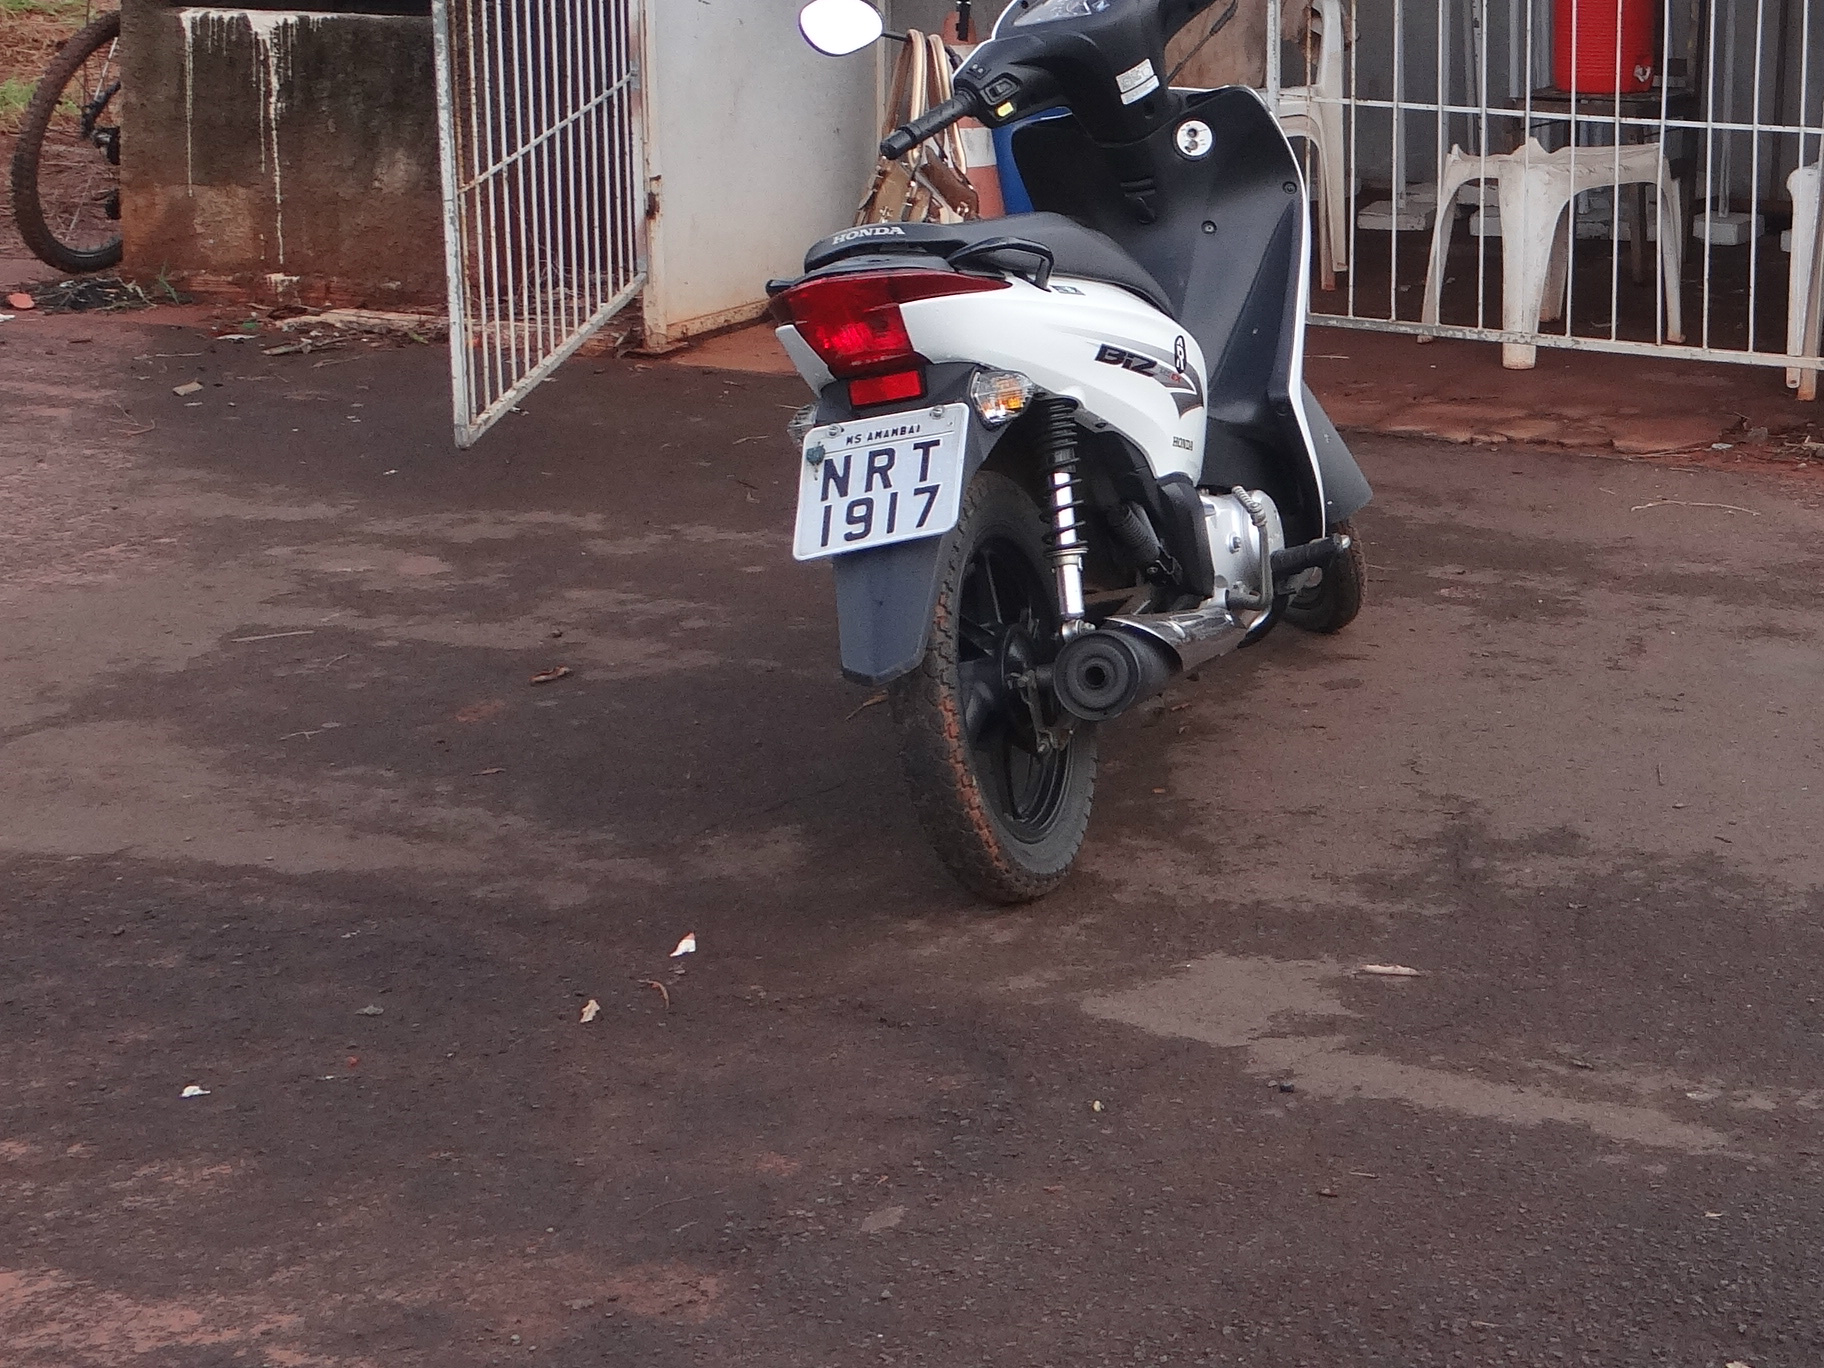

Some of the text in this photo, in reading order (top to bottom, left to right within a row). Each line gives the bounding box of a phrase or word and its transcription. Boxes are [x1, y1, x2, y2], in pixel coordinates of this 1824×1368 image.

[831, 226, 906, 246] HONDA
[846, 424, 921, 446] MS AMAMBAI
[1172, 435, 1194, 452] HONDA
[820, 438, 942, 502] NRT
[820, 483, 942, 548] 1917
